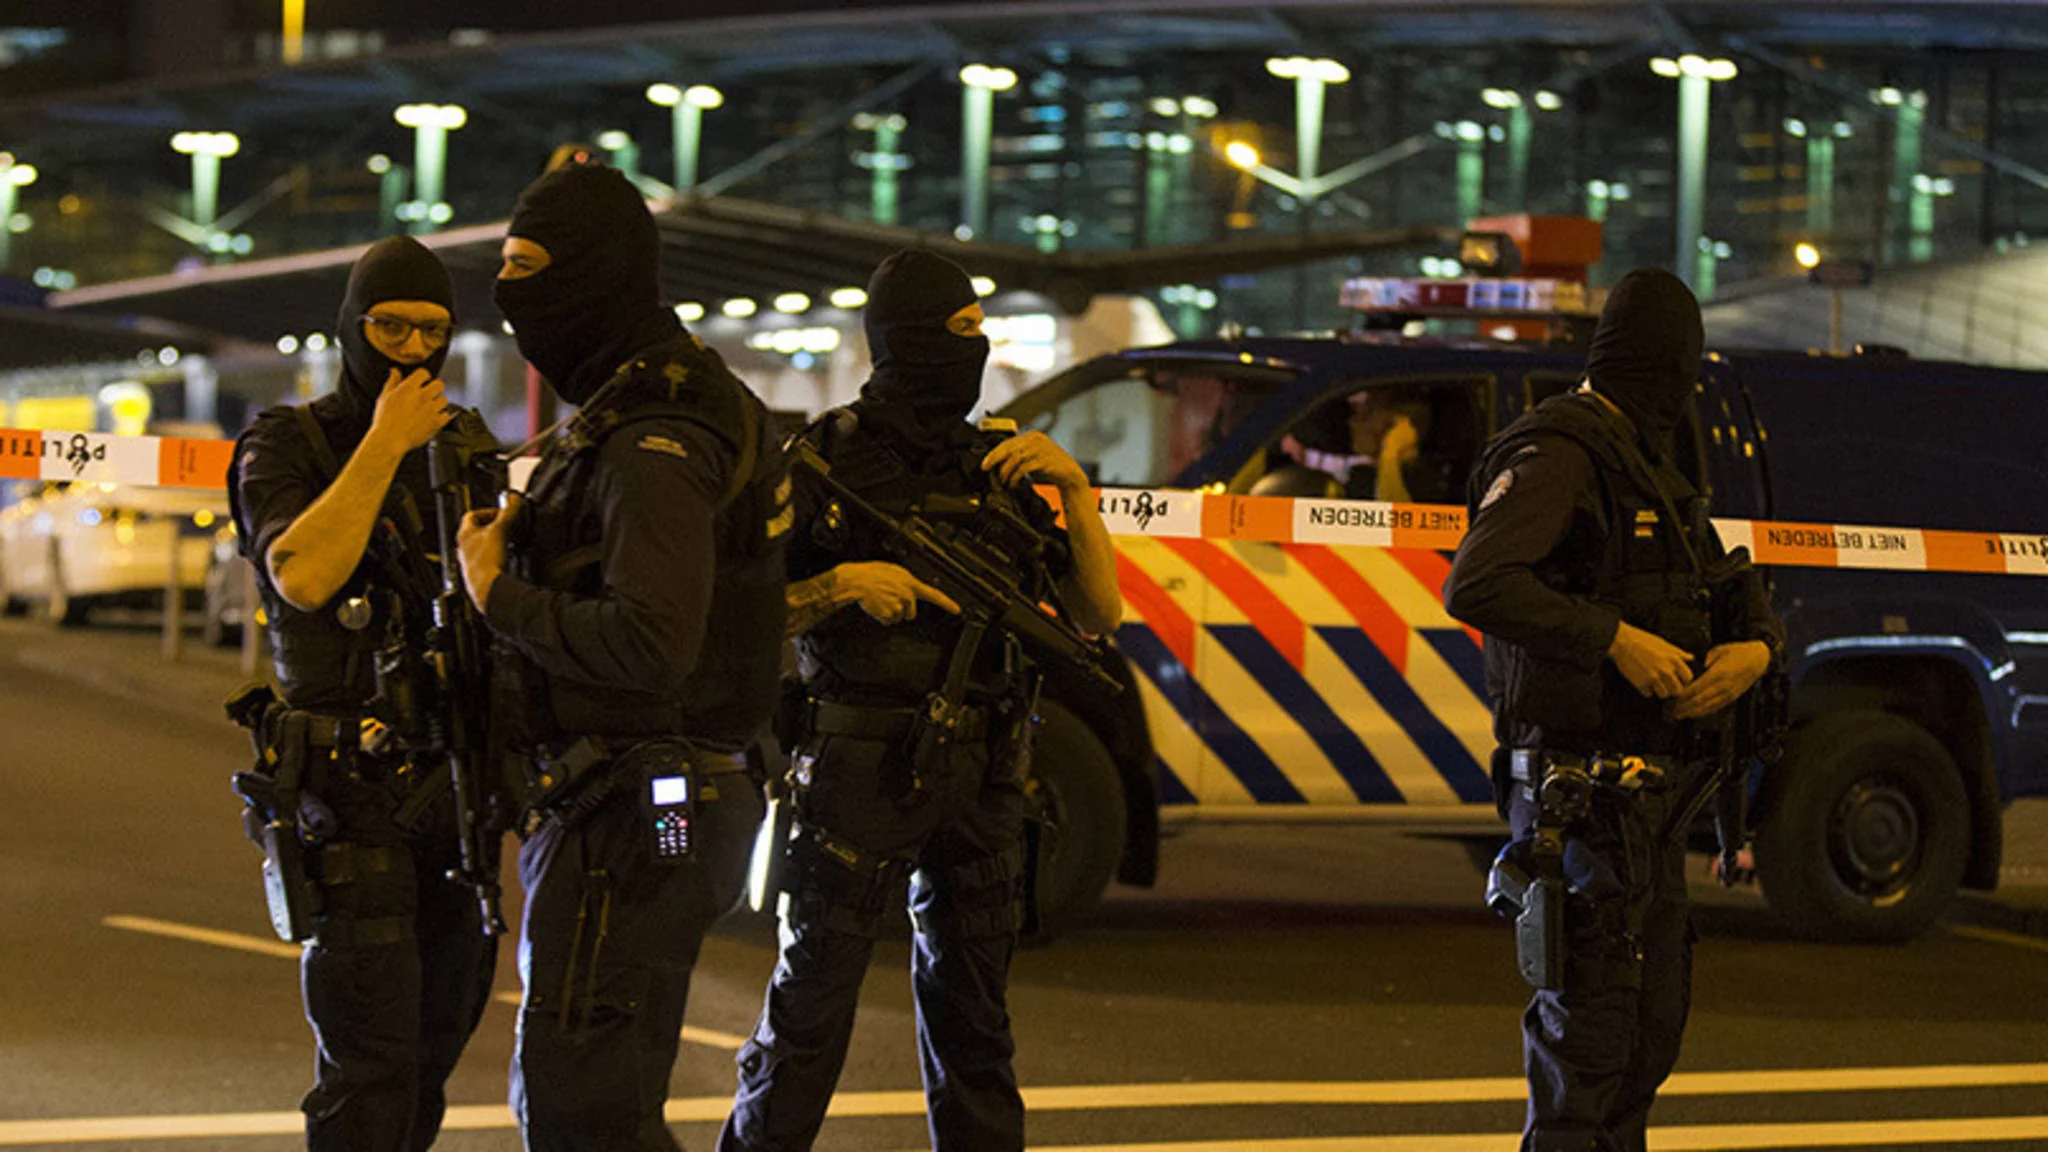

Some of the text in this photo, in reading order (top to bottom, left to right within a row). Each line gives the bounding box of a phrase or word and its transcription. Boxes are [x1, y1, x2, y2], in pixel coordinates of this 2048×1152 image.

[1309, 506, 1461, 531] NIET BETREDEN
[1767, 528, 1907, 551] NIET BETREDEN
